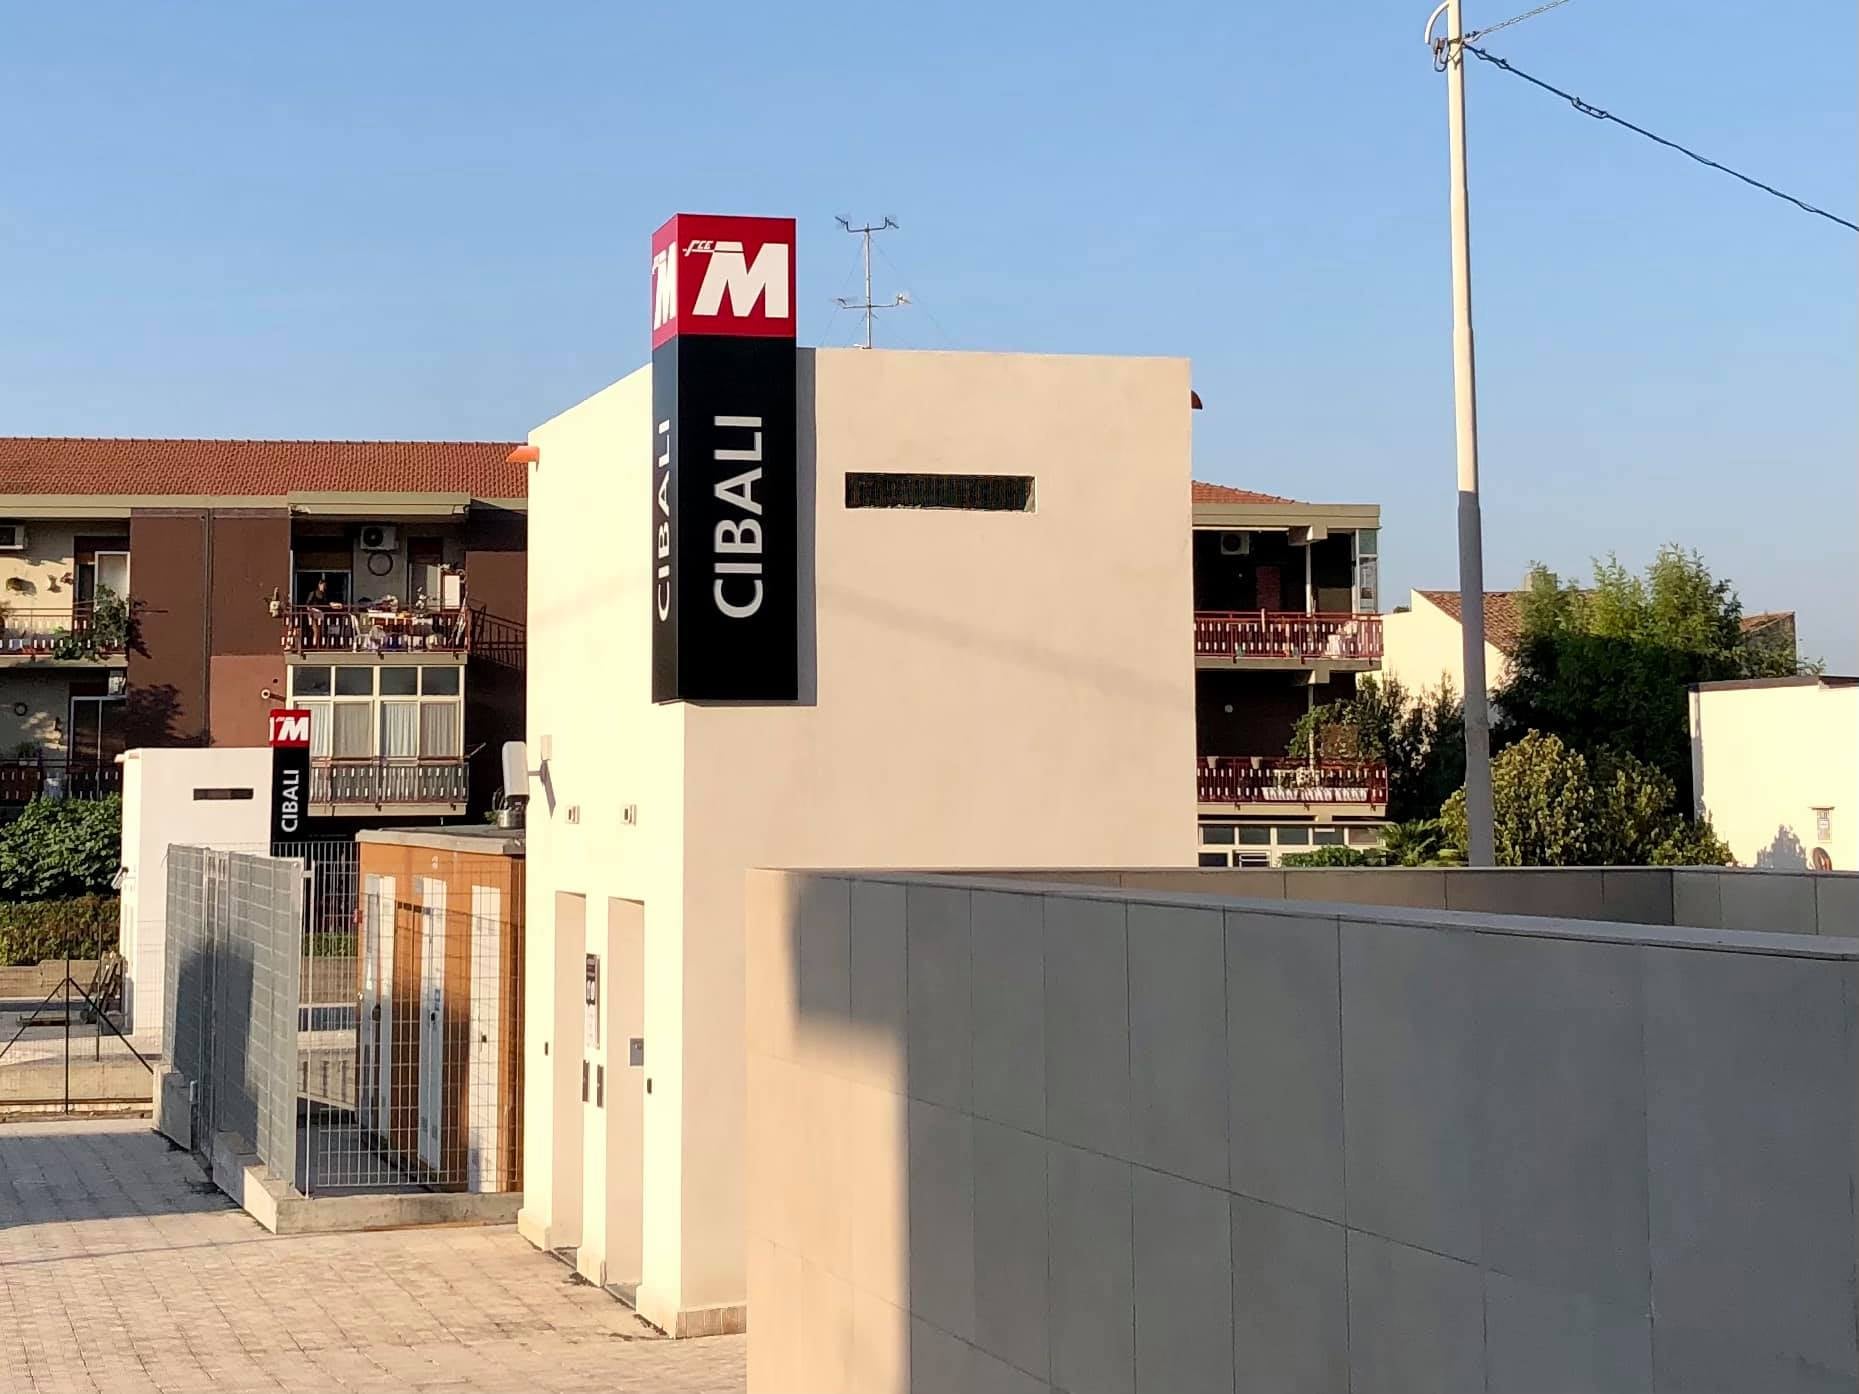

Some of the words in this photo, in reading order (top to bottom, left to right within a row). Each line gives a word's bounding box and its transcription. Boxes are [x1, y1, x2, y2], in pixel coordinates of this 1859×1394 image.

[692, 241, 789, 319] M
[658, 419, 671, 622] CIBALI
[714, 415, 764, 618] CIBALI
[277, 716, 309, 741] M
[281, 769, 300, 833] CIBALI
